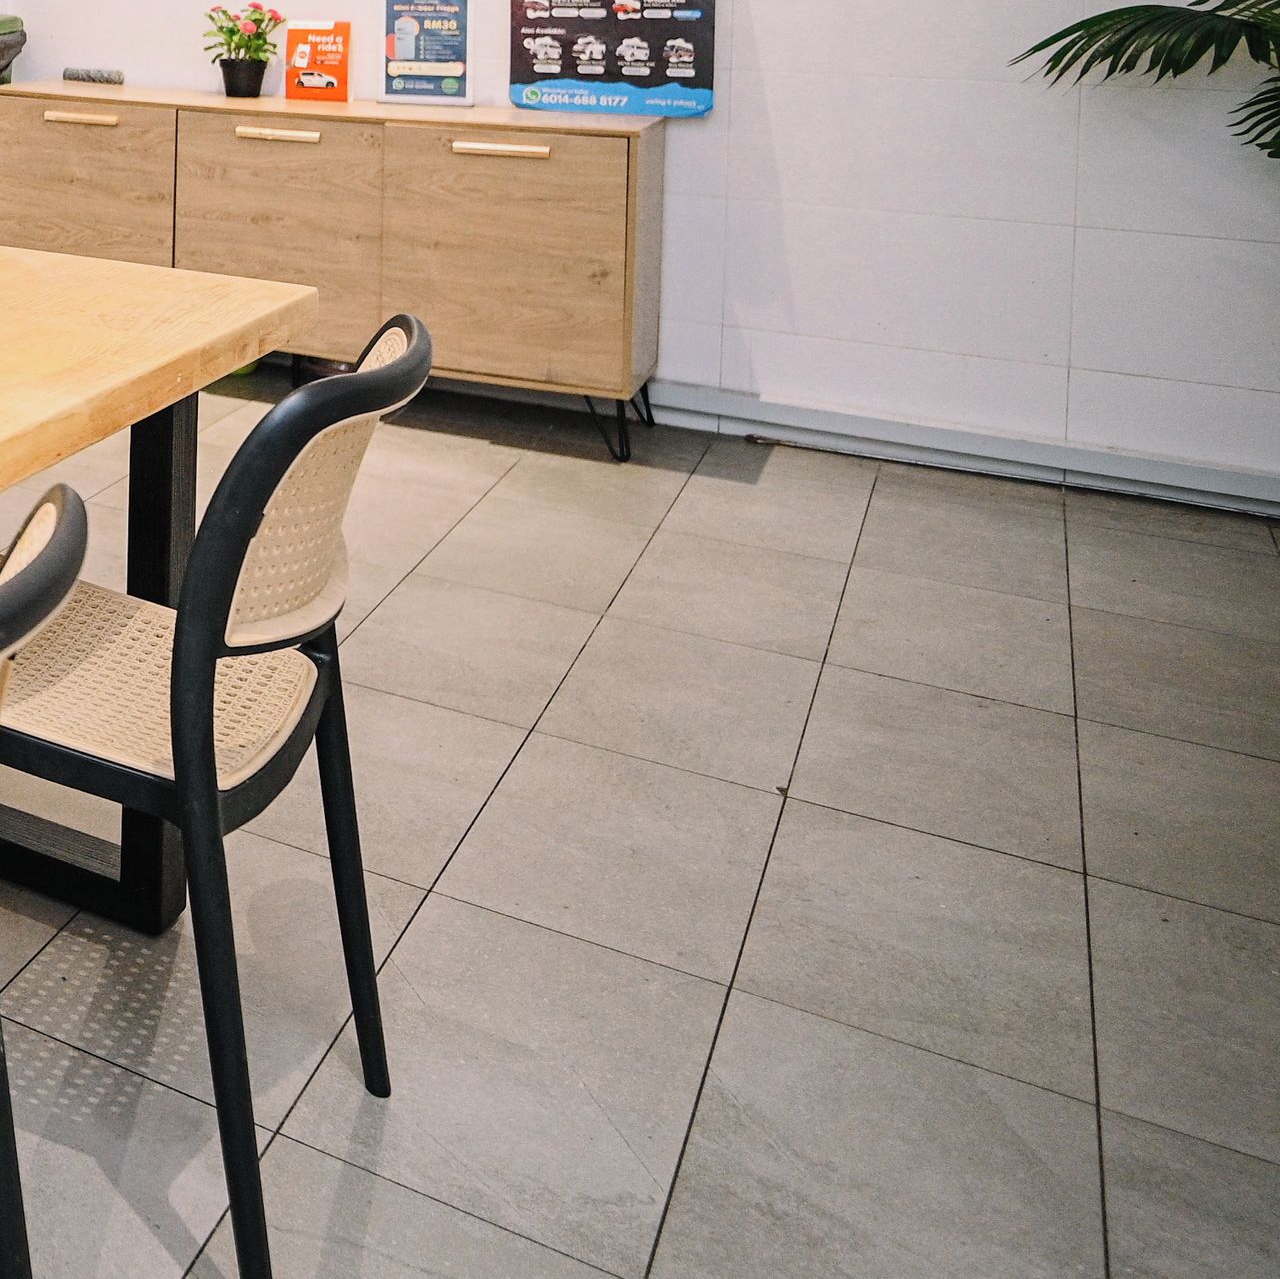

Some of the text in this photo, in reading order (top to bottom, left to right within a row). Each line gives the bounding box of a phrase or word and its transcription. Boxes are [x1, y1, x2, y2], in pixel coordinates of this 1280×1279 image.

[423, 19, 457, 30] RM30
[307, 33, 334, 43] Need
[542, 95, 628, 107] 6014-688 8177
